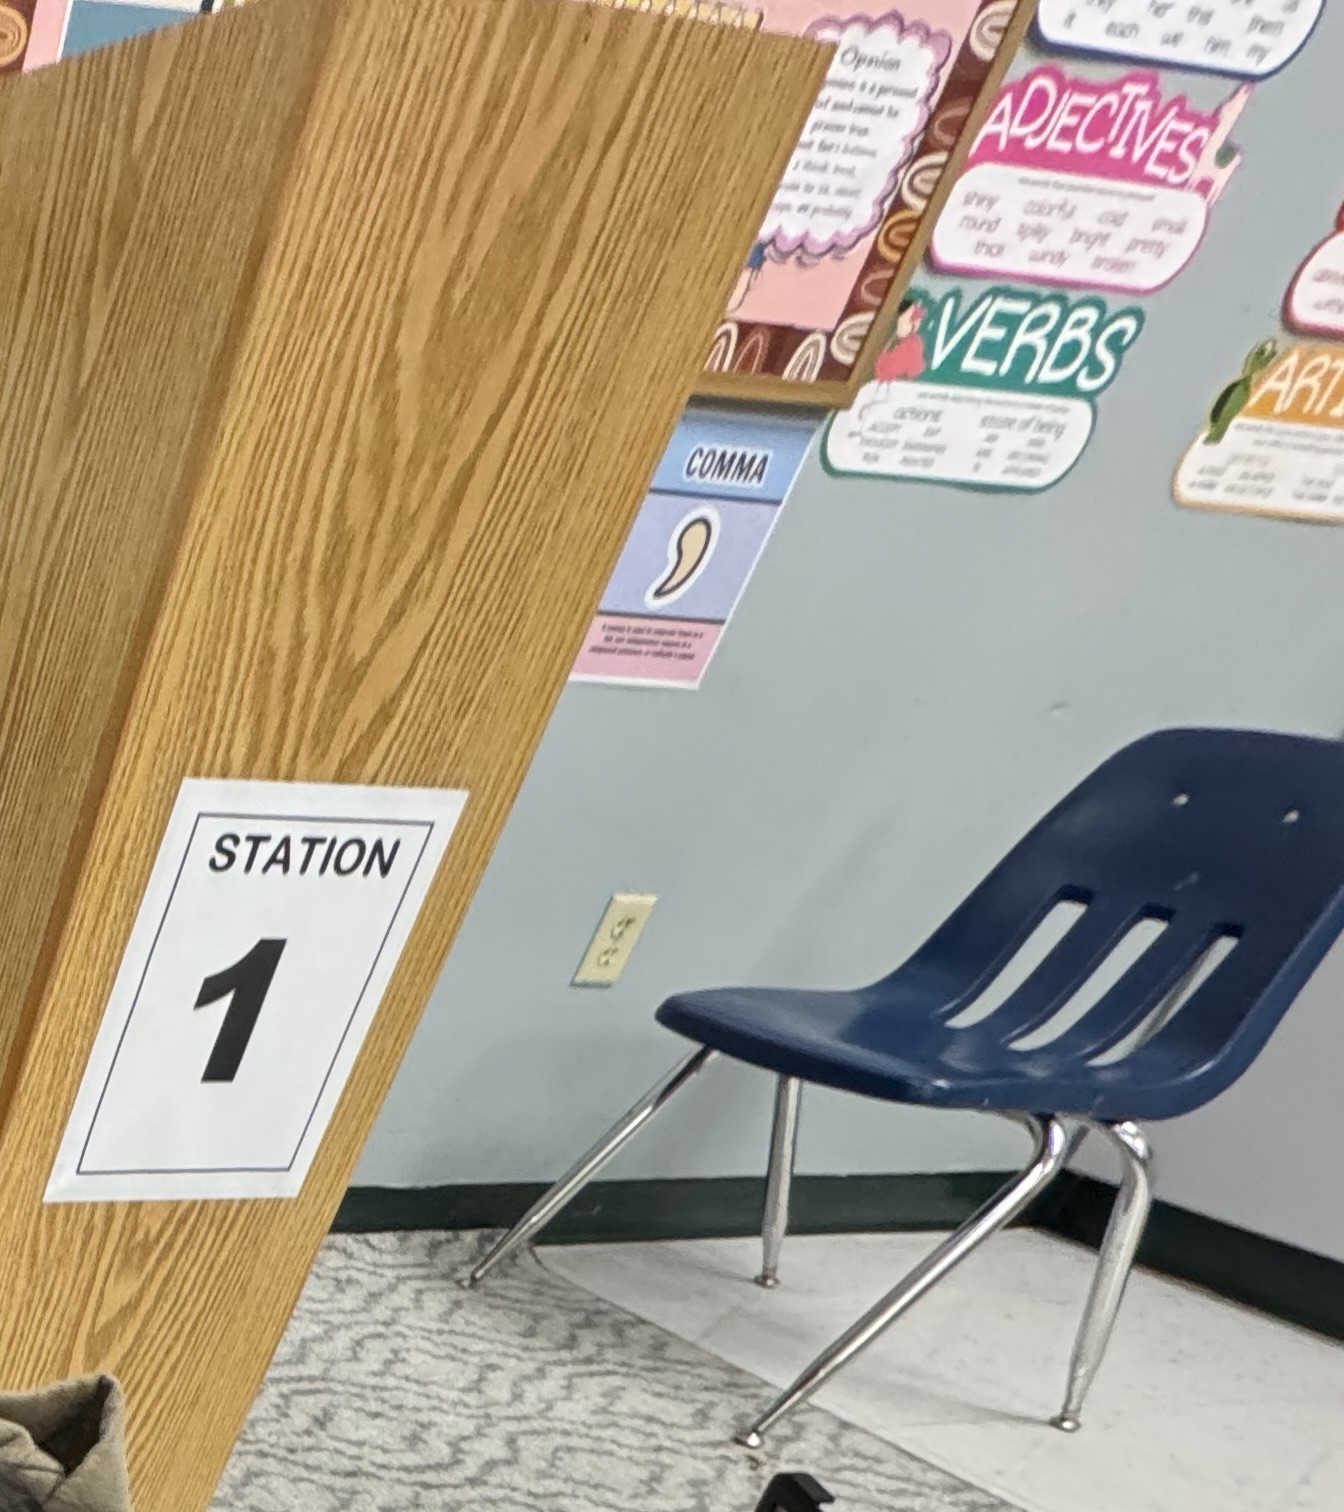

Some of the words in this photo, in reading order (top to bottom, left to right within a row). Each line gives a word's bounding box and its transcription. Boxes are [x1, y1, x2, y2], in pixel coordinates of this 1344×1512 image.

[840, 44, 902, 72] Opinion
[970, 77, 1213, 187] ADJECTIVES
[927, 294, 1138, 395] VERBS
[685, 446, 770, 486] COMMA
[208, 832, 402, 879] STATION
[193, 937, 288, 1084] 1
